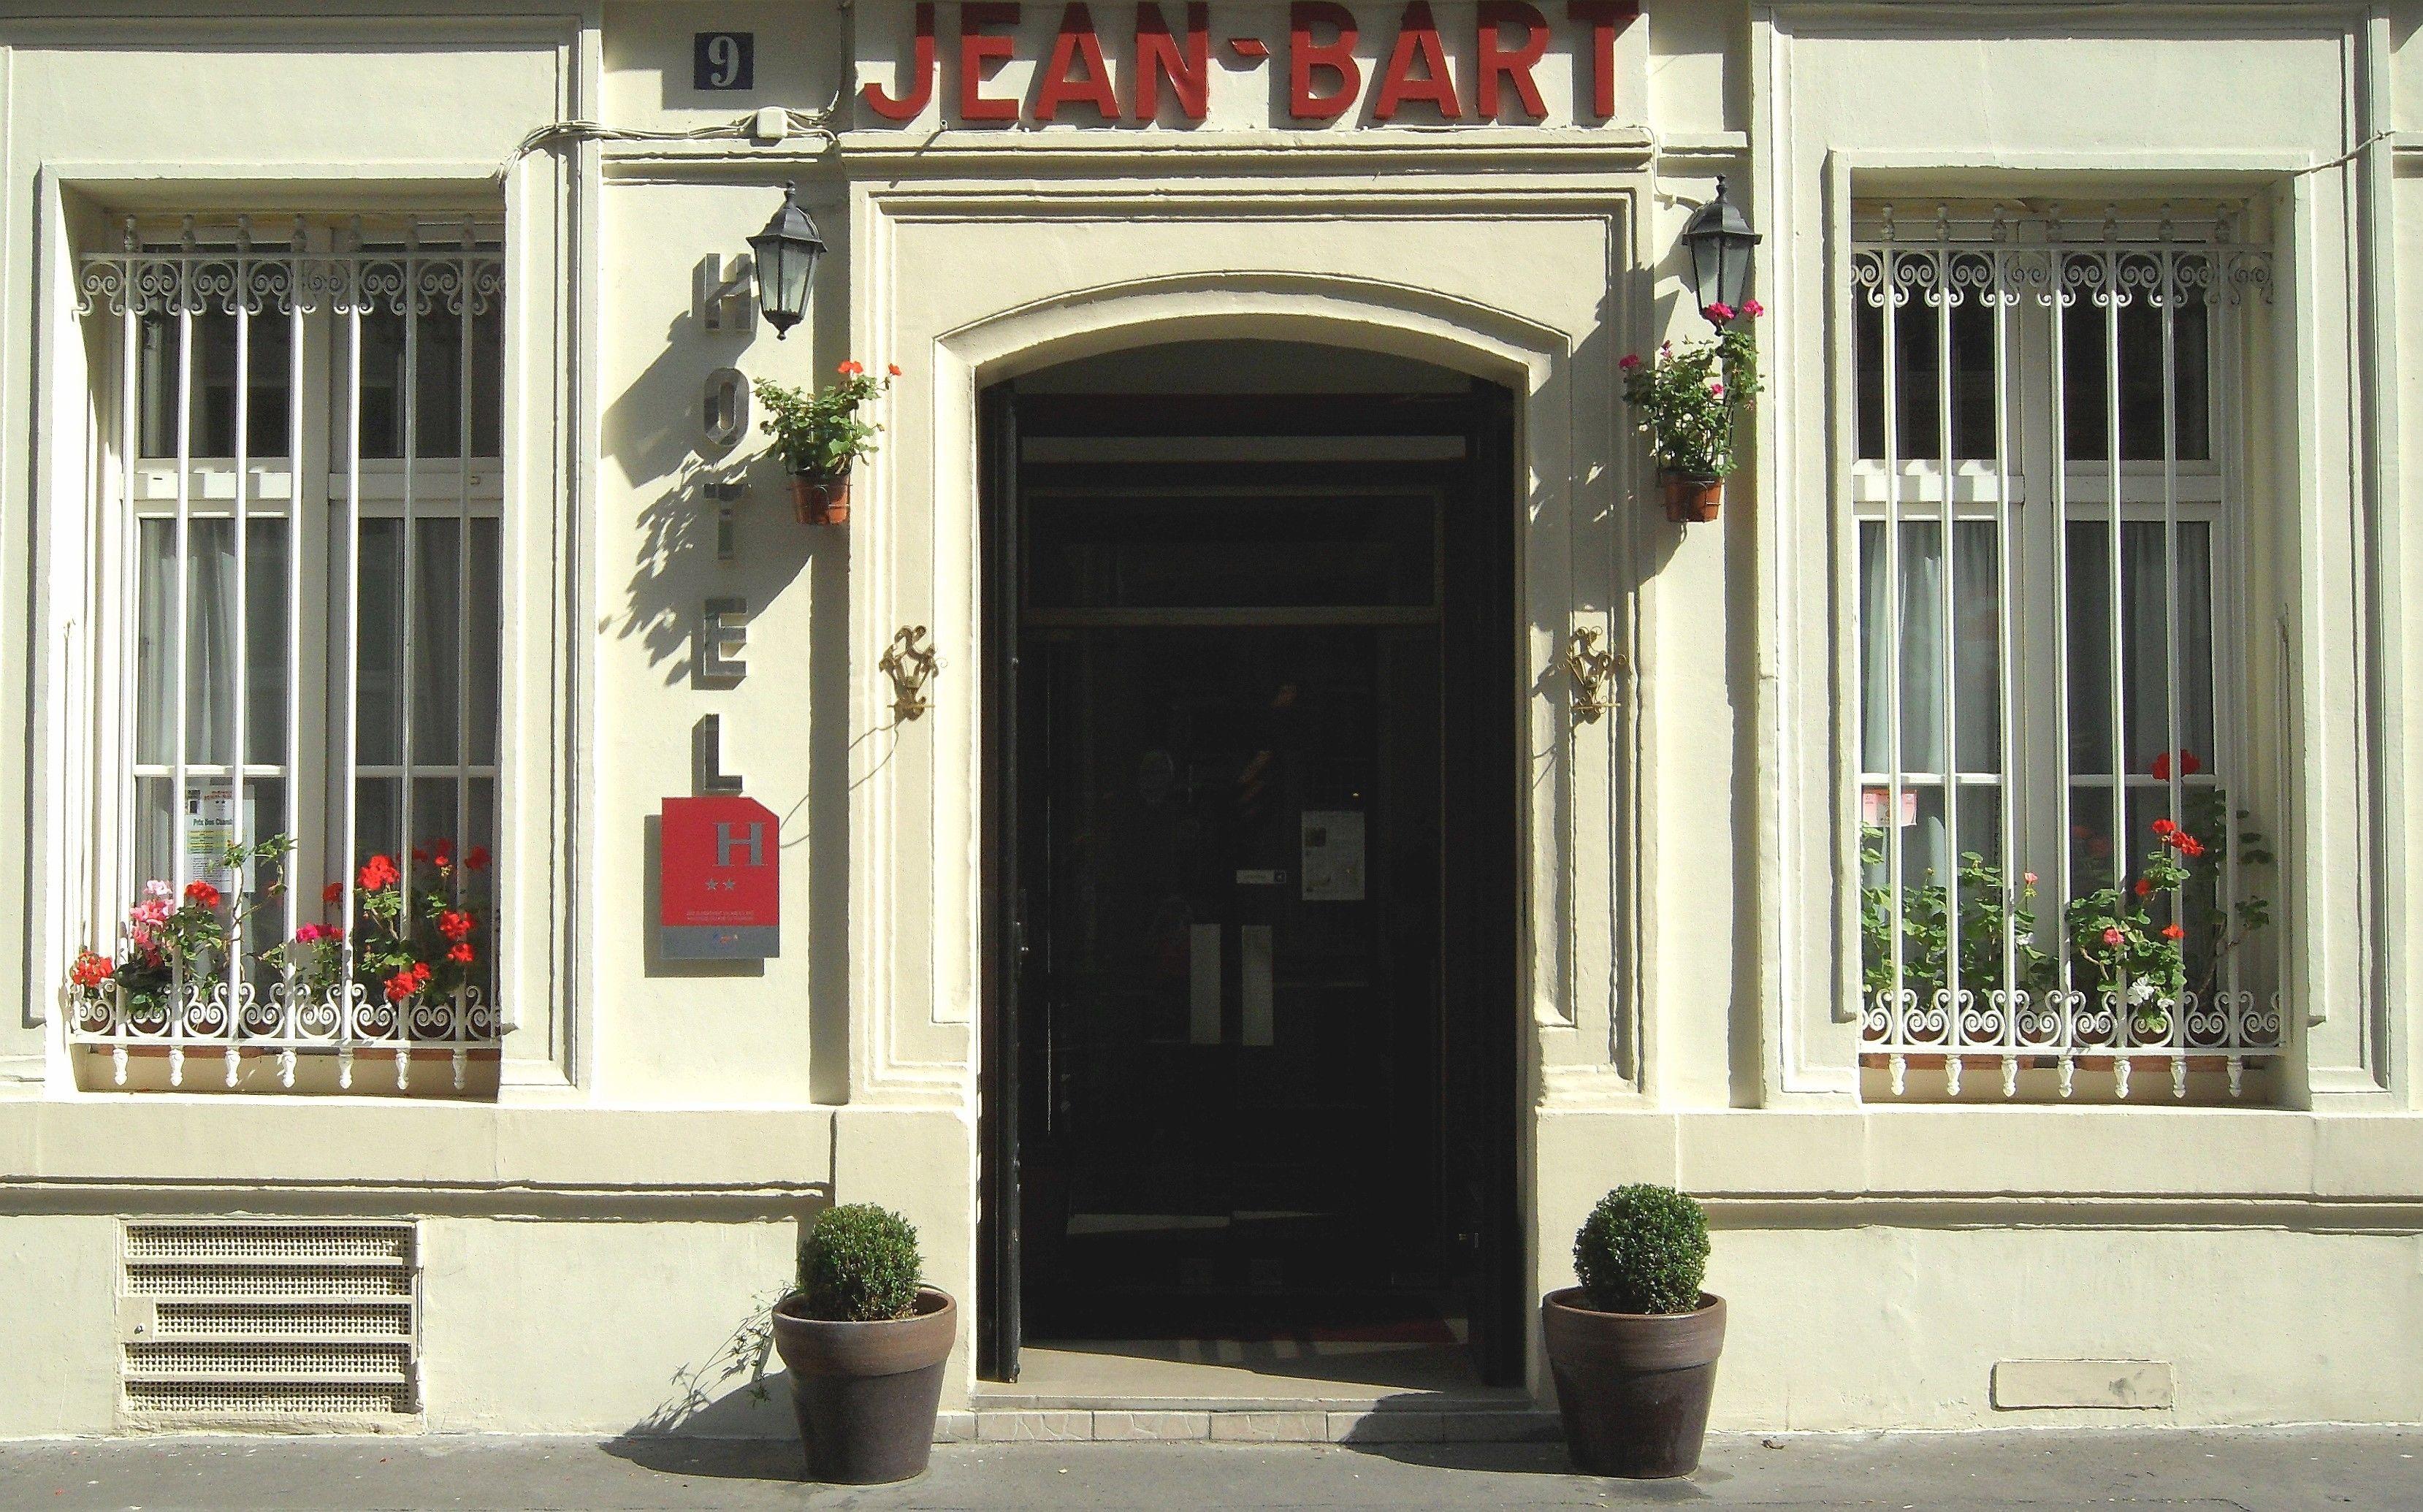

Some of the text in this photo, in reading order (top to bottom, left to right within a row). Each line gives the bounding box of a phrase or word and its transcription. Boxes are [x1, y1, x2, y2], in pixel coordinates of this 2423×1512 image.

[707, 35, 741, 87] 9
[863, 1, 1639, 121] JEAN-BART
[704, 253, 752, 791] HOTEL
[712, 822, 768, 867] H
